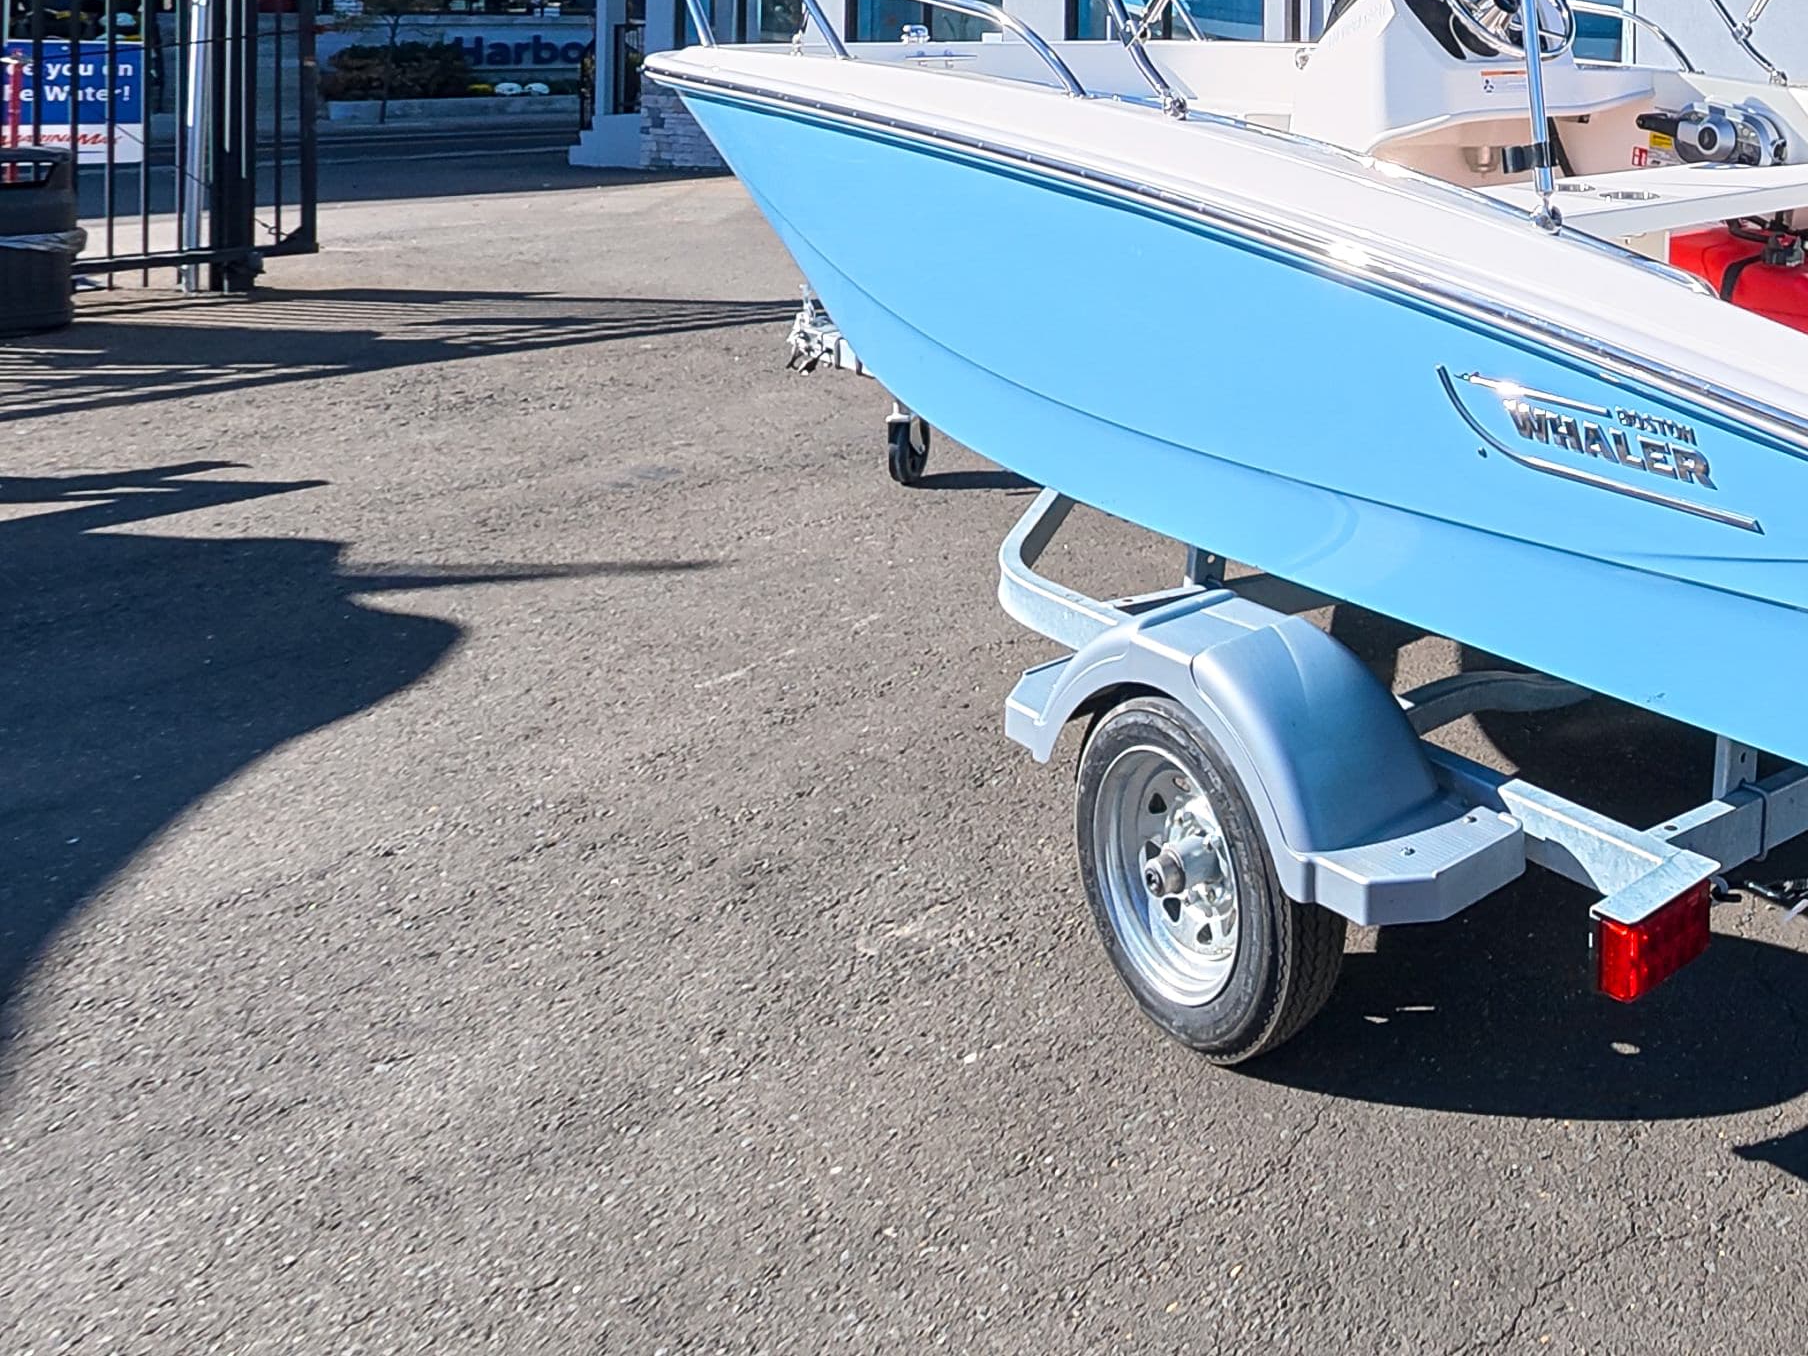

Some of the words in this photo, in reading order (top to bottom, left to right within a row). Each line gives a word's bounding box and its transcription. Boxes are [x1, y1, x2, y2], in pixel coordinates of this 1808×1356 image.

[46, 62, 94, 80] you
[1502, 399, 1718, 491] WHALER
[1615, 406, 1697, 446] BOSTON
